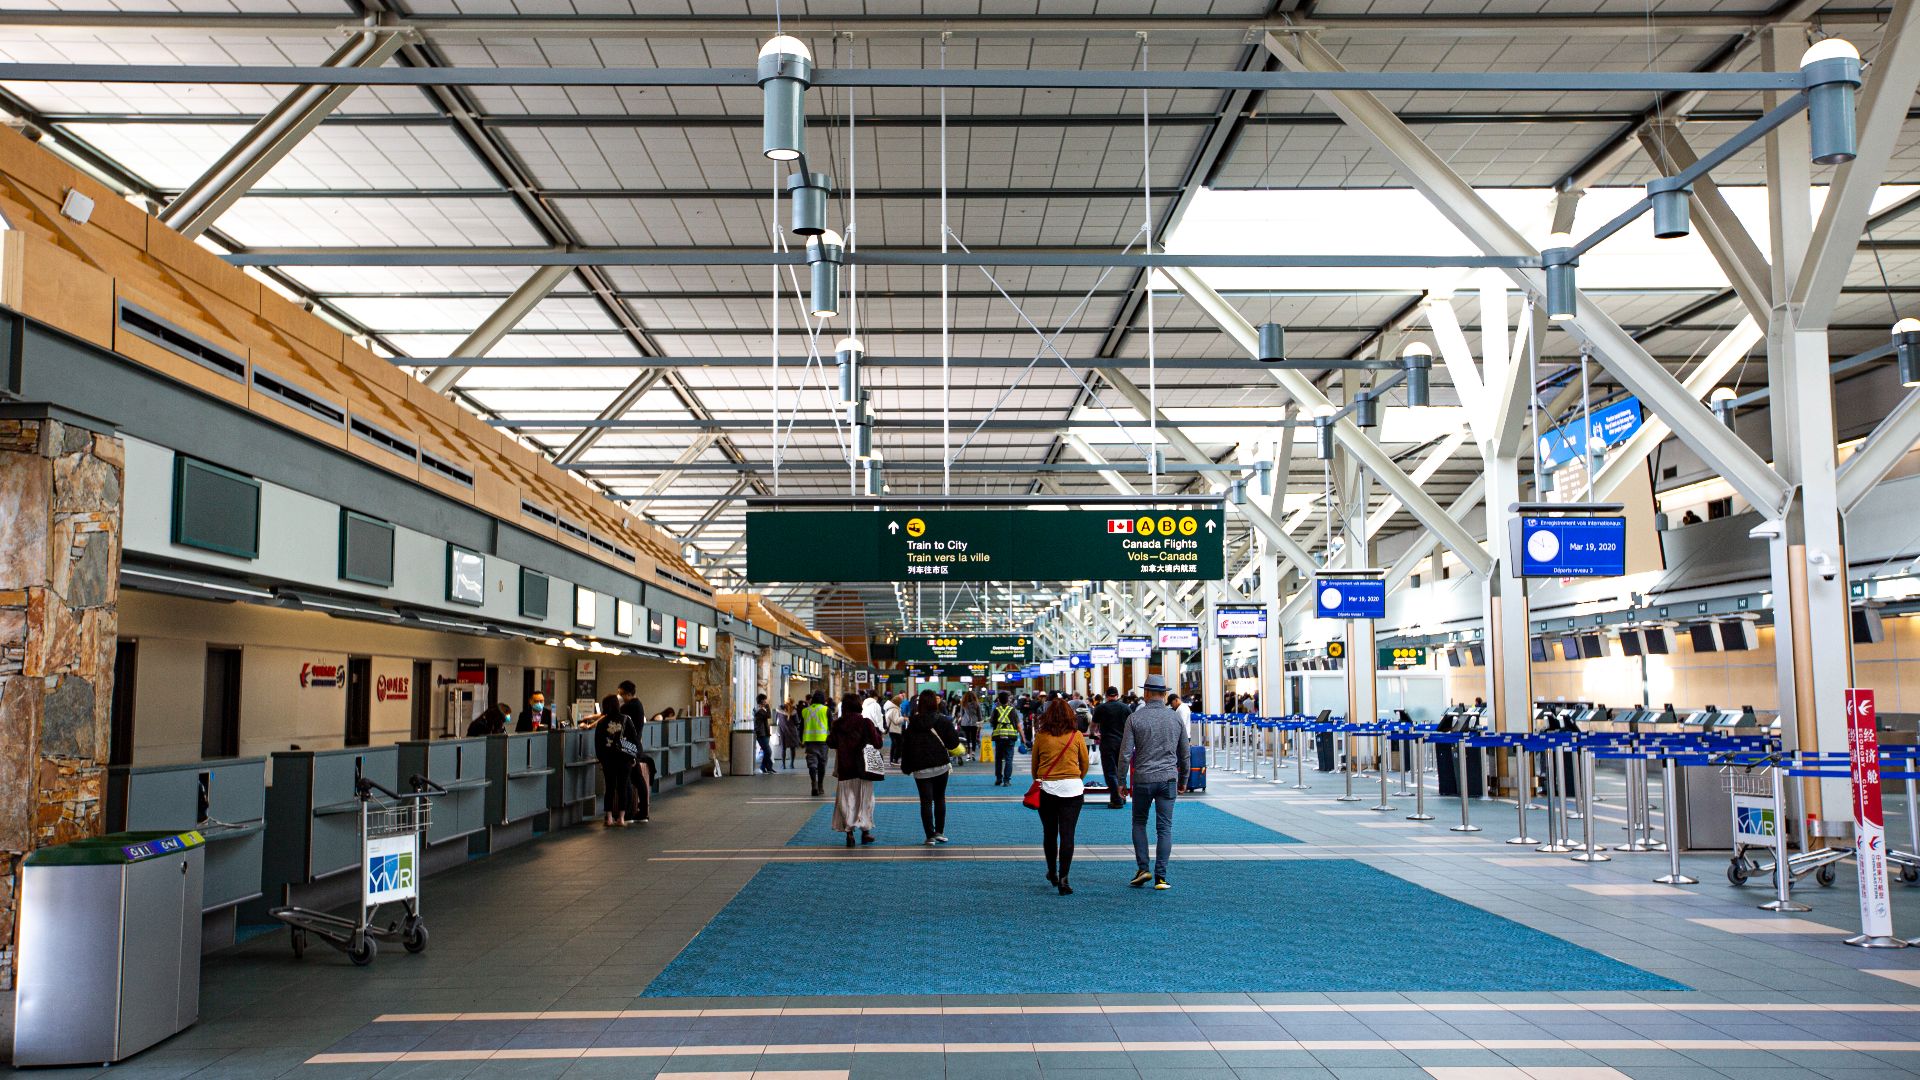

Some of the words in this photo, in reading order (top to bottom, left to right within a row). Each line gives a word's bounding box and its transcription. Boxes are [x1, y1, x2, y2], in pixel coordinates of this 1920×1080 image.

[1141, 520, 1151, 532] A
[1162, 520, 1172, 532] B
[1183, 520, 1193, 532] C
[907, 540, 931, 550] Train
[934, 540, 945, 550] to
[947, 540, 968, 552] City
[1122, 539, 1161, 549] Canada
[1164, 539, 1198, 550] Flights
[1569, 543, 1584, 551] Mar
[1586, 543, 1597, 552] 19,
[1598, 543, 1616, 551] 2020
[907, 553, 931, 562] Train
[934, 554, 955, 562] vers
[958, 553, 967, 562] la
[970, 553, 990, 562] ville
[907, 565, 949, 575] 列车往市区
[1858, 728, 1866, 768] ECONOMY
[1863, 728, 1879, 784] 经济舱
[1738, 818, 1776, 837] YVR
[370, 867, 412, 894] YVR
